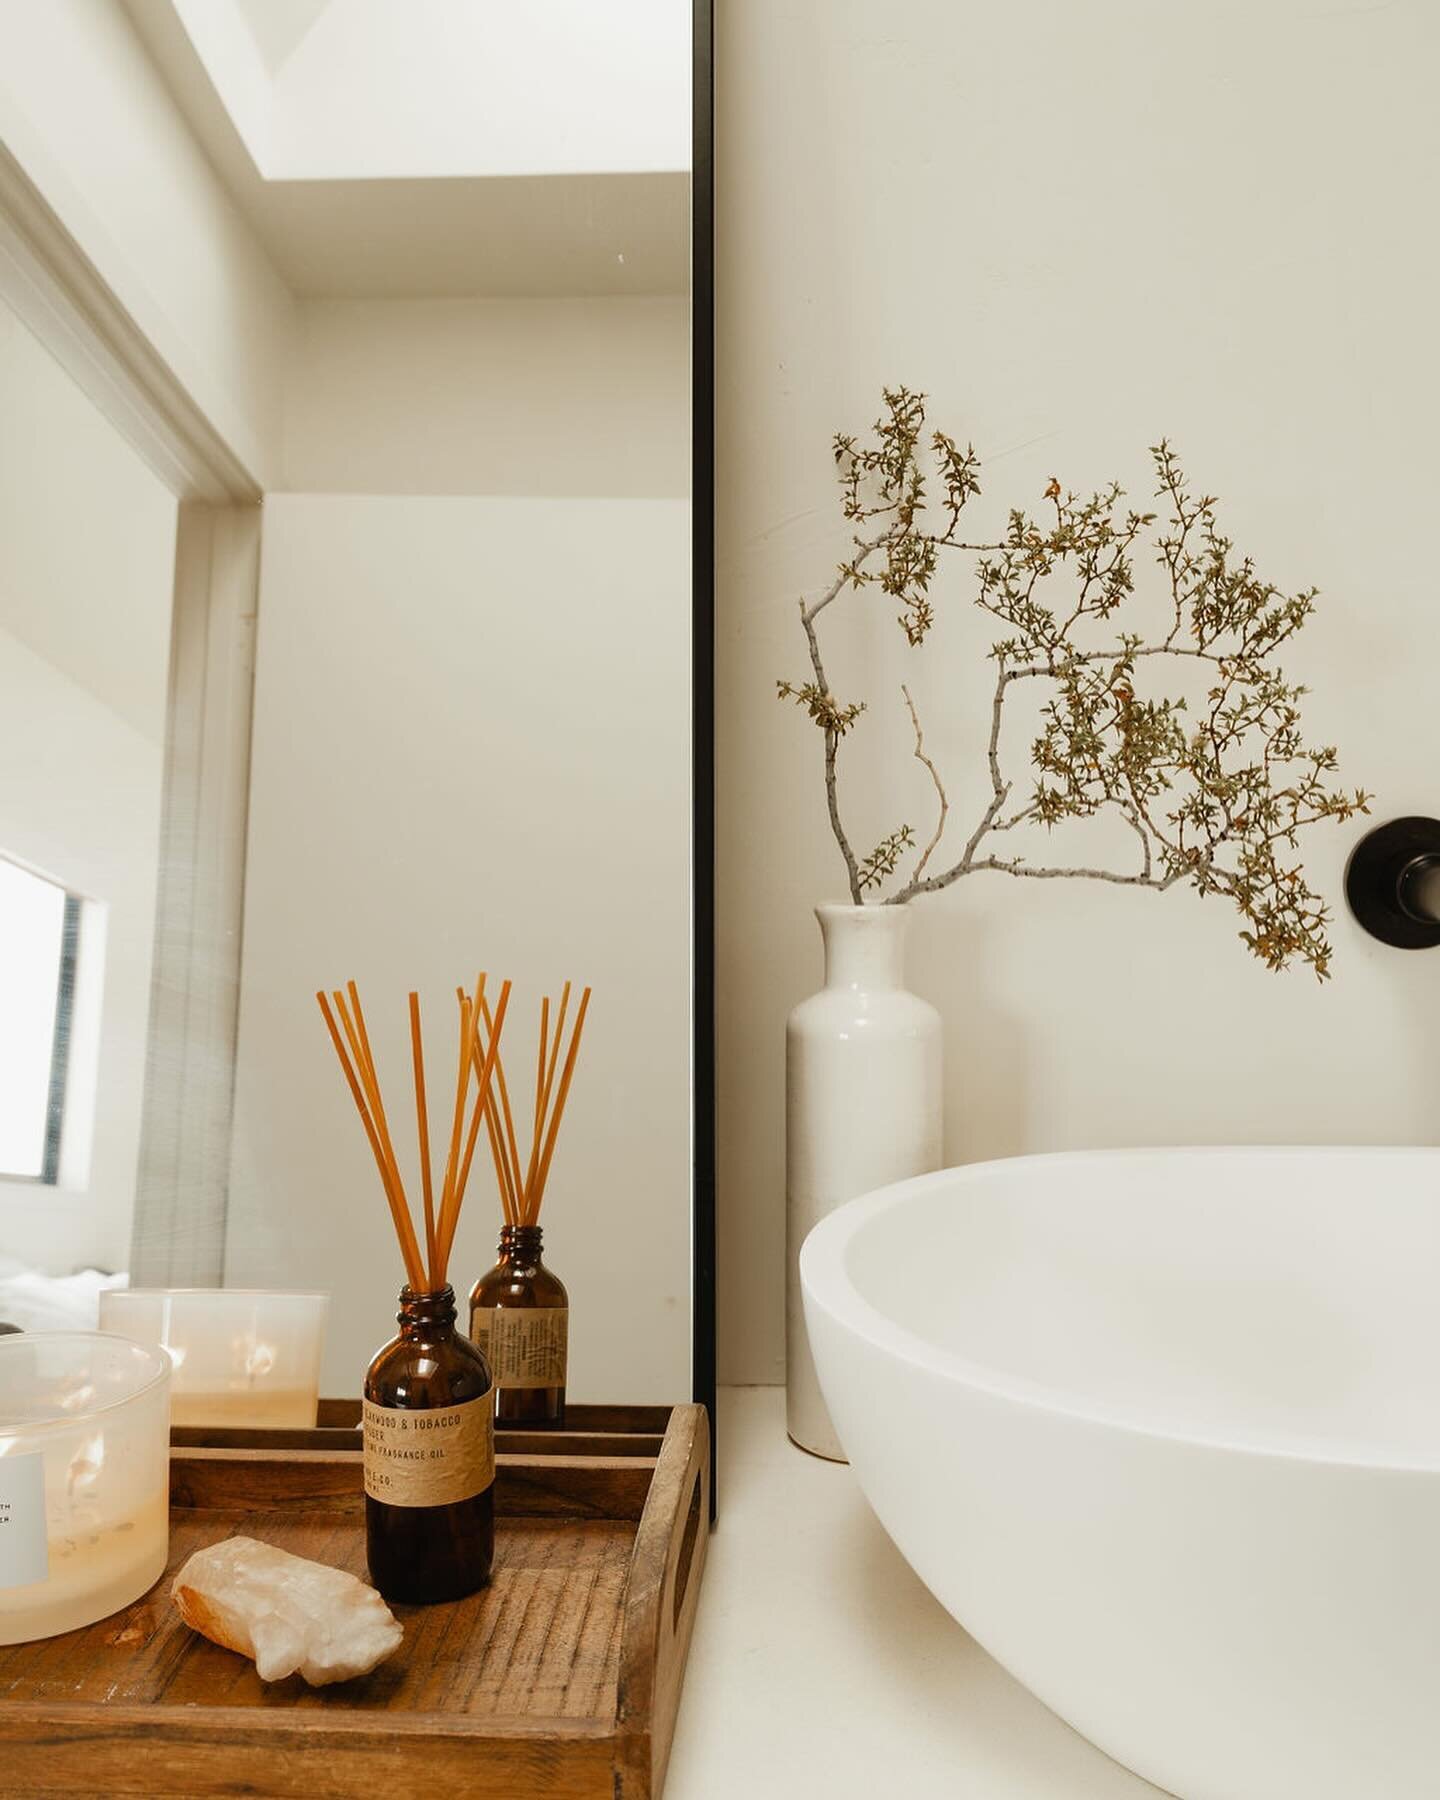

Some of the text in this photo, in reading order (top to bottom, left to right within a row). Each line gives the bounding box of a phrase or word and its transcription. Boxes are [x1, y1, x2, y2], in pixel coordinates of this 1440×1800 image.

[401, 1418, 408, 1430] &
[413, 1414, 461, 1430] TOBACCO
[378, 1446, 425, 1460] FRAGRANCE
[430, 1449, 445, 1459] OIL
